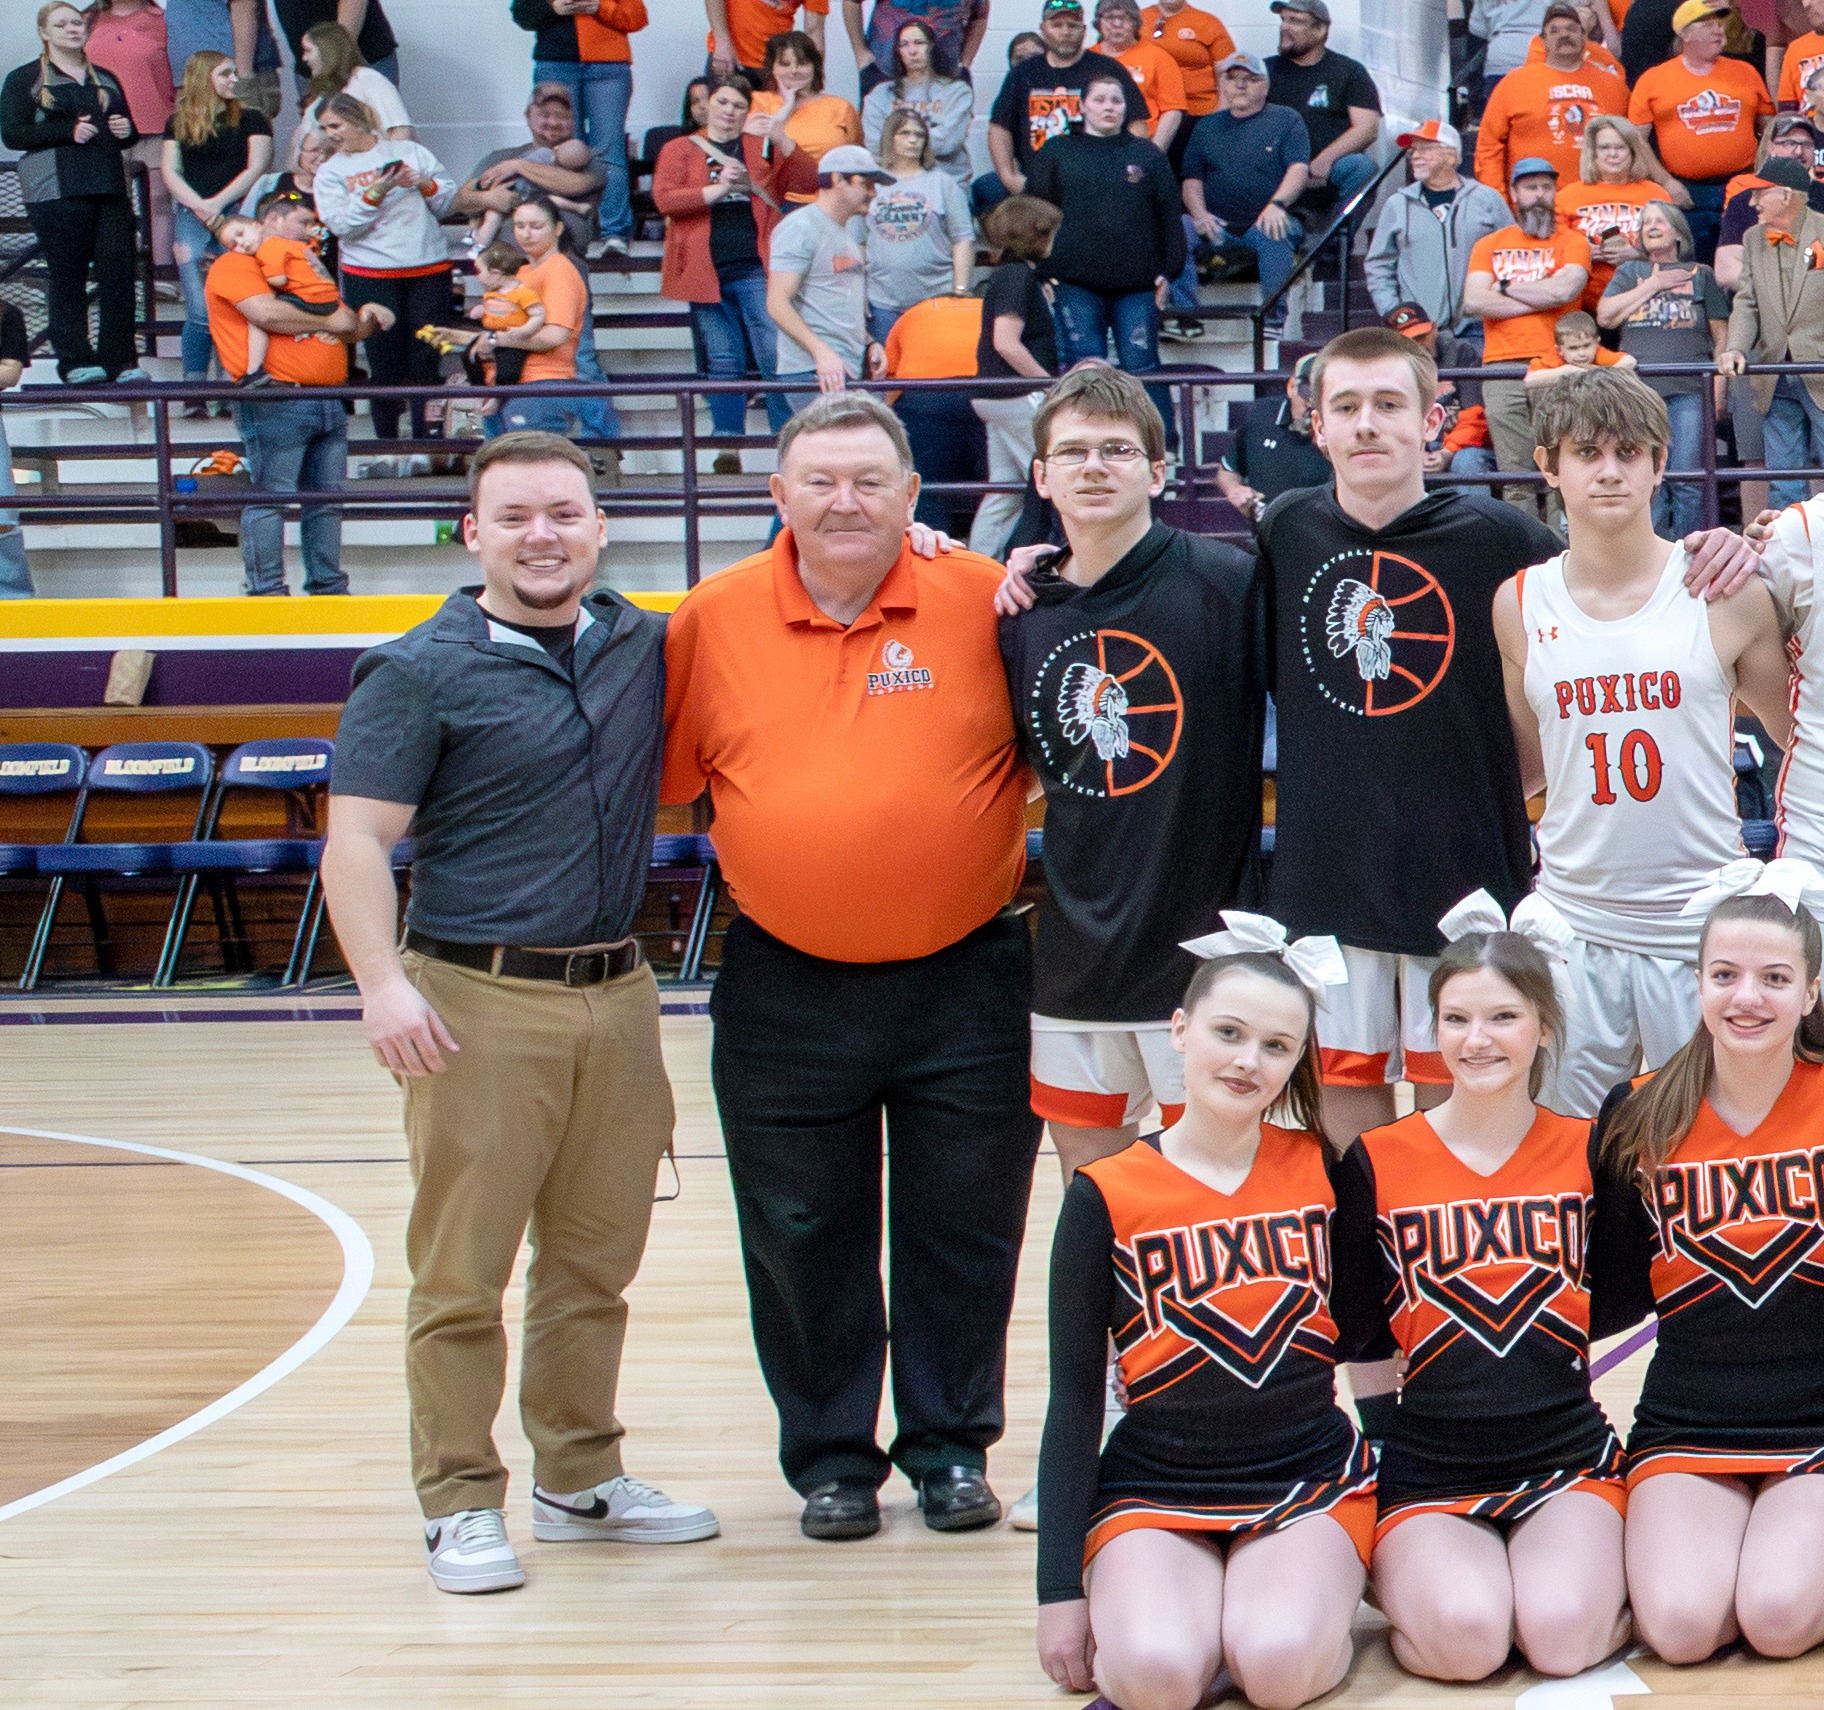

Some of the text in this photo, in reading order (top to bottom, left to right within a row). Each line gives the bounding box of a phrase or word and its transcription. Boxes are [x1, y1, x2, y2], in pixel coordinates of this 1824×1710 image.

[1303, 550, 1372, 603] BASKETBALL
[867, 668, 931, 690] PUXICO
[1554, 670, 1681, 719] PUXICO
[1586, 728, 1664, 805] 10
[1132, 1205, 1332, 1338] PUXICO
[1391, 1195, 1586, 1310] PUXICO
